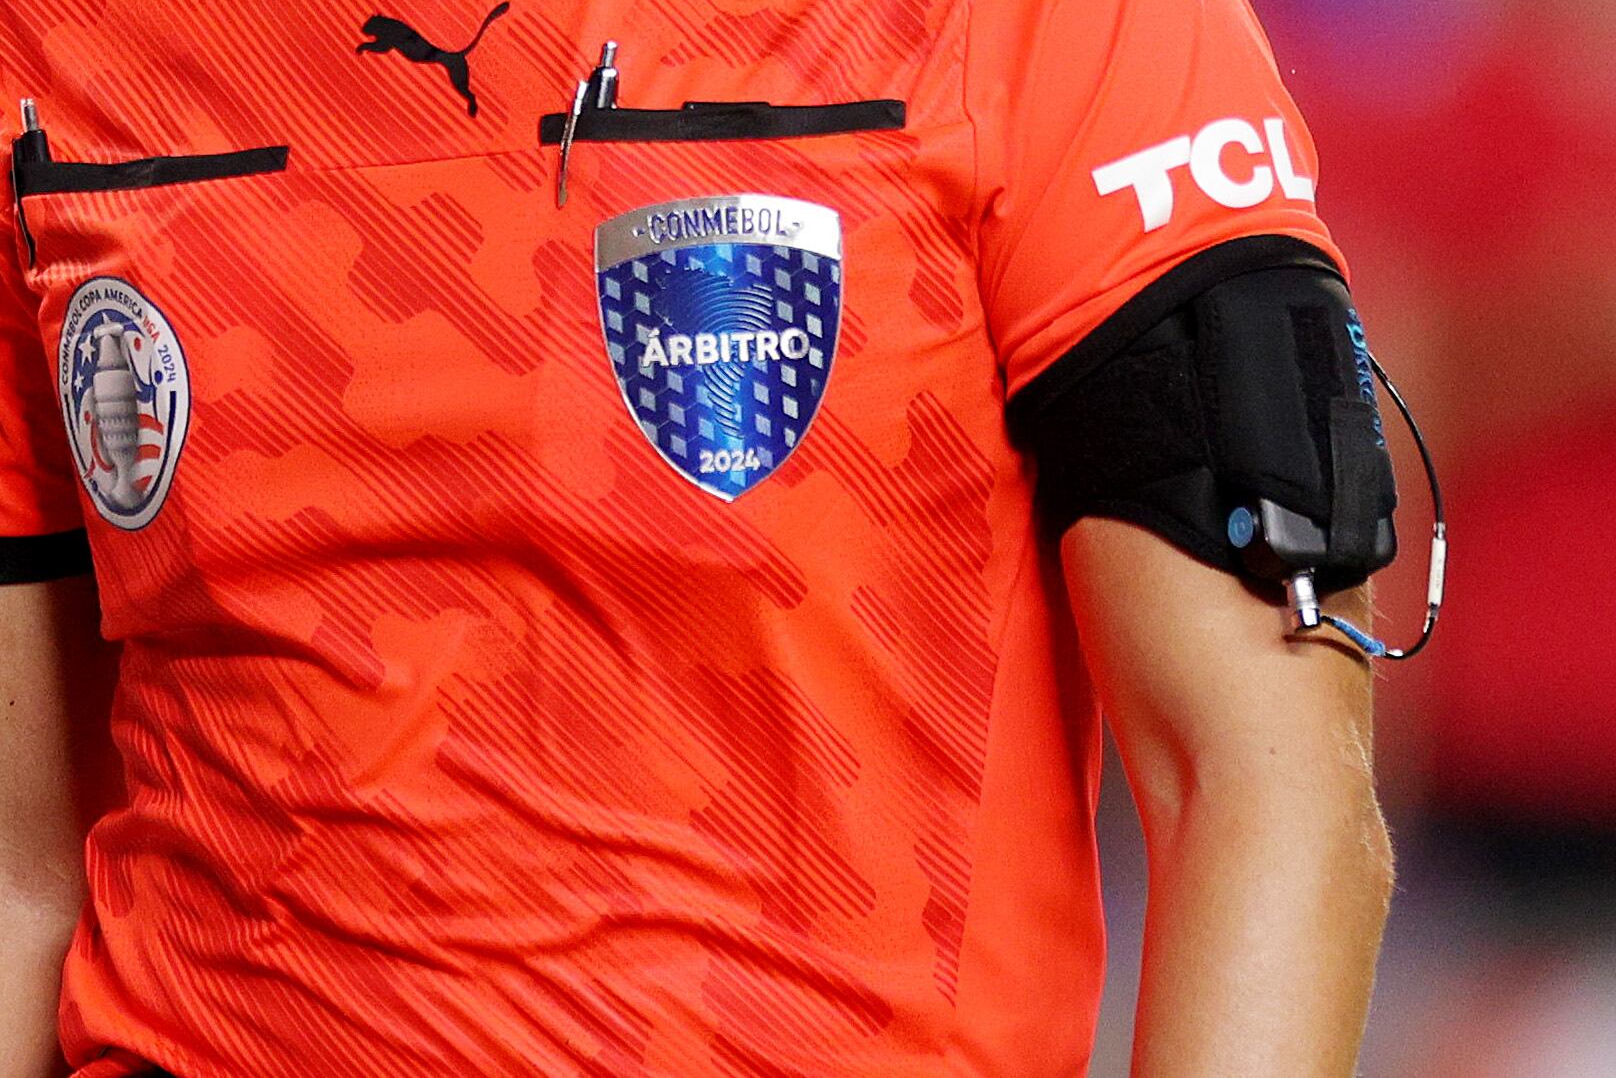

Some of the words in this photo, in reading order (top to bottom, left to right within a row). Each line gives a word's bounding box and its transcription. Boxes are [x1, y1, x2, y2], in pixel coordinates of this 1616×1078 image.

[1092, 118, 1315, 233] TCL
[647, 207, 785, 243] CONMEBOL
[62, 308, 82, 384] CONMEBOL
[79, 289, 102, 312] COPA
[104, 288, 143, 319] AMERICA
[158, 344, 176, 382] 2024
[642, 328, 809, 367] ÁRBITRO
[699, 448, 760, 473] 2024
